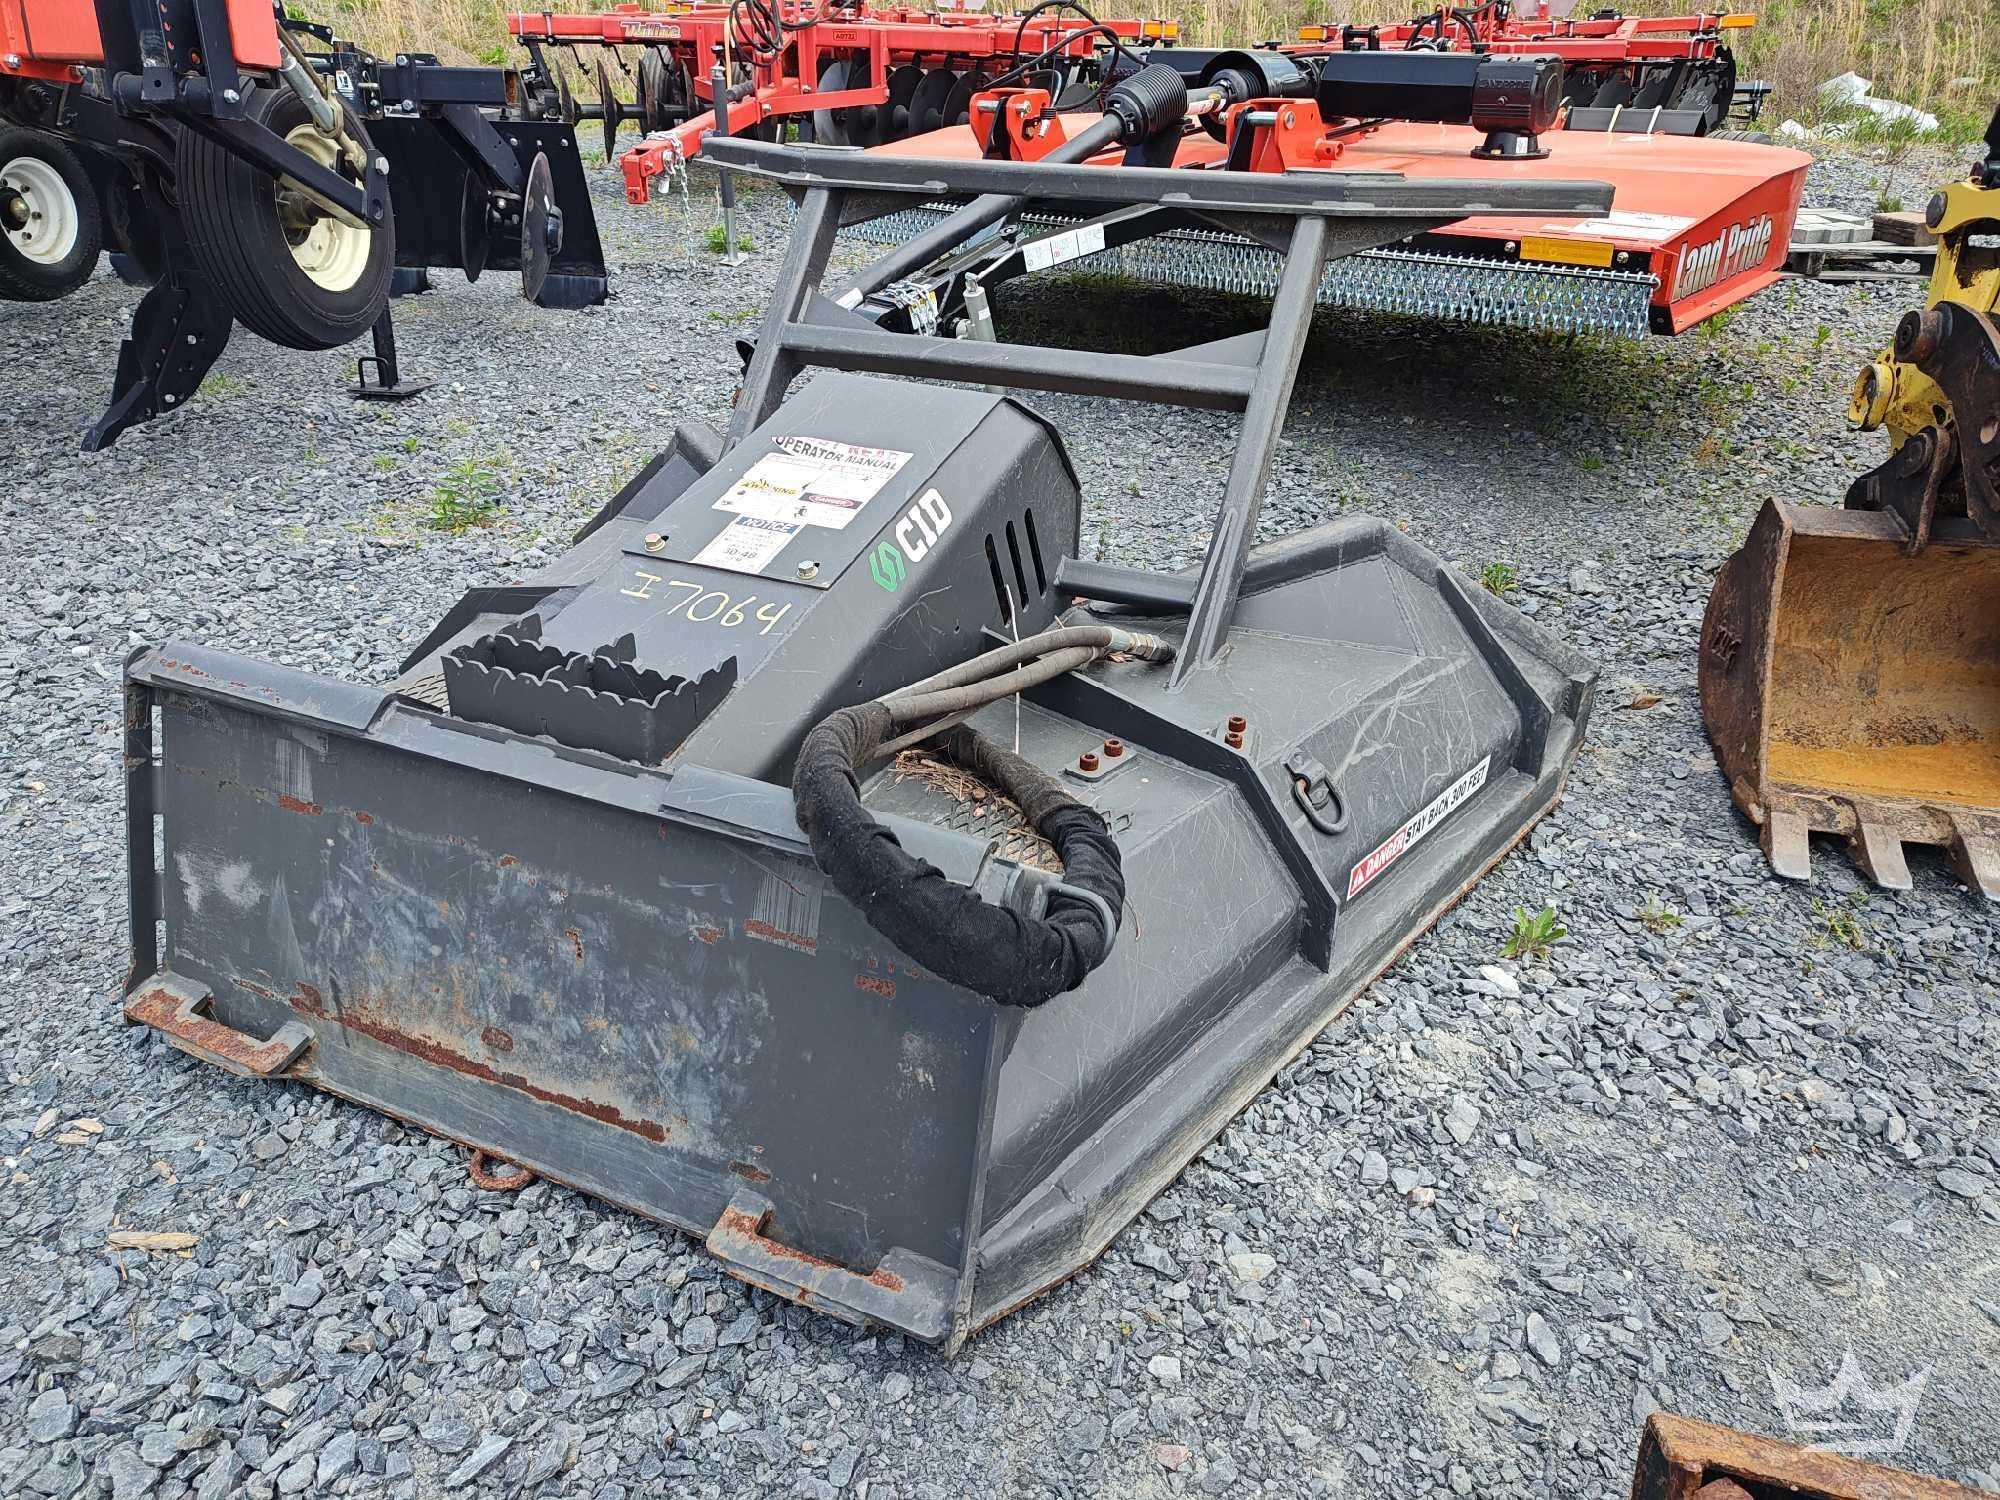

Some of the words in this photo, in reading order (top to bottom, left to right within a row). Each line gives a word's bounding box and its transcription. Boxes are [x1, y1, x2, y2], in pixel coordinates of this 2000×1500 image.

[1671, 228, 1728, 304] Land
[1722, 212, 1773, 280] Pride
[776, 436, 841, 462] OPERATOR
[844, 455, 898, 471] MANUAL
[742, 518, 793, 534] NOTICE
[895, 488, 953, 563] CID
[1366, 835, 1405, 876] DANGER
[1405, 814, 1427, 843] STAY
[1428, 795, 1450, 824] BACK
[1450, 781, 1467, 806] 300
[1467, 766, 1487, 792] FEET
